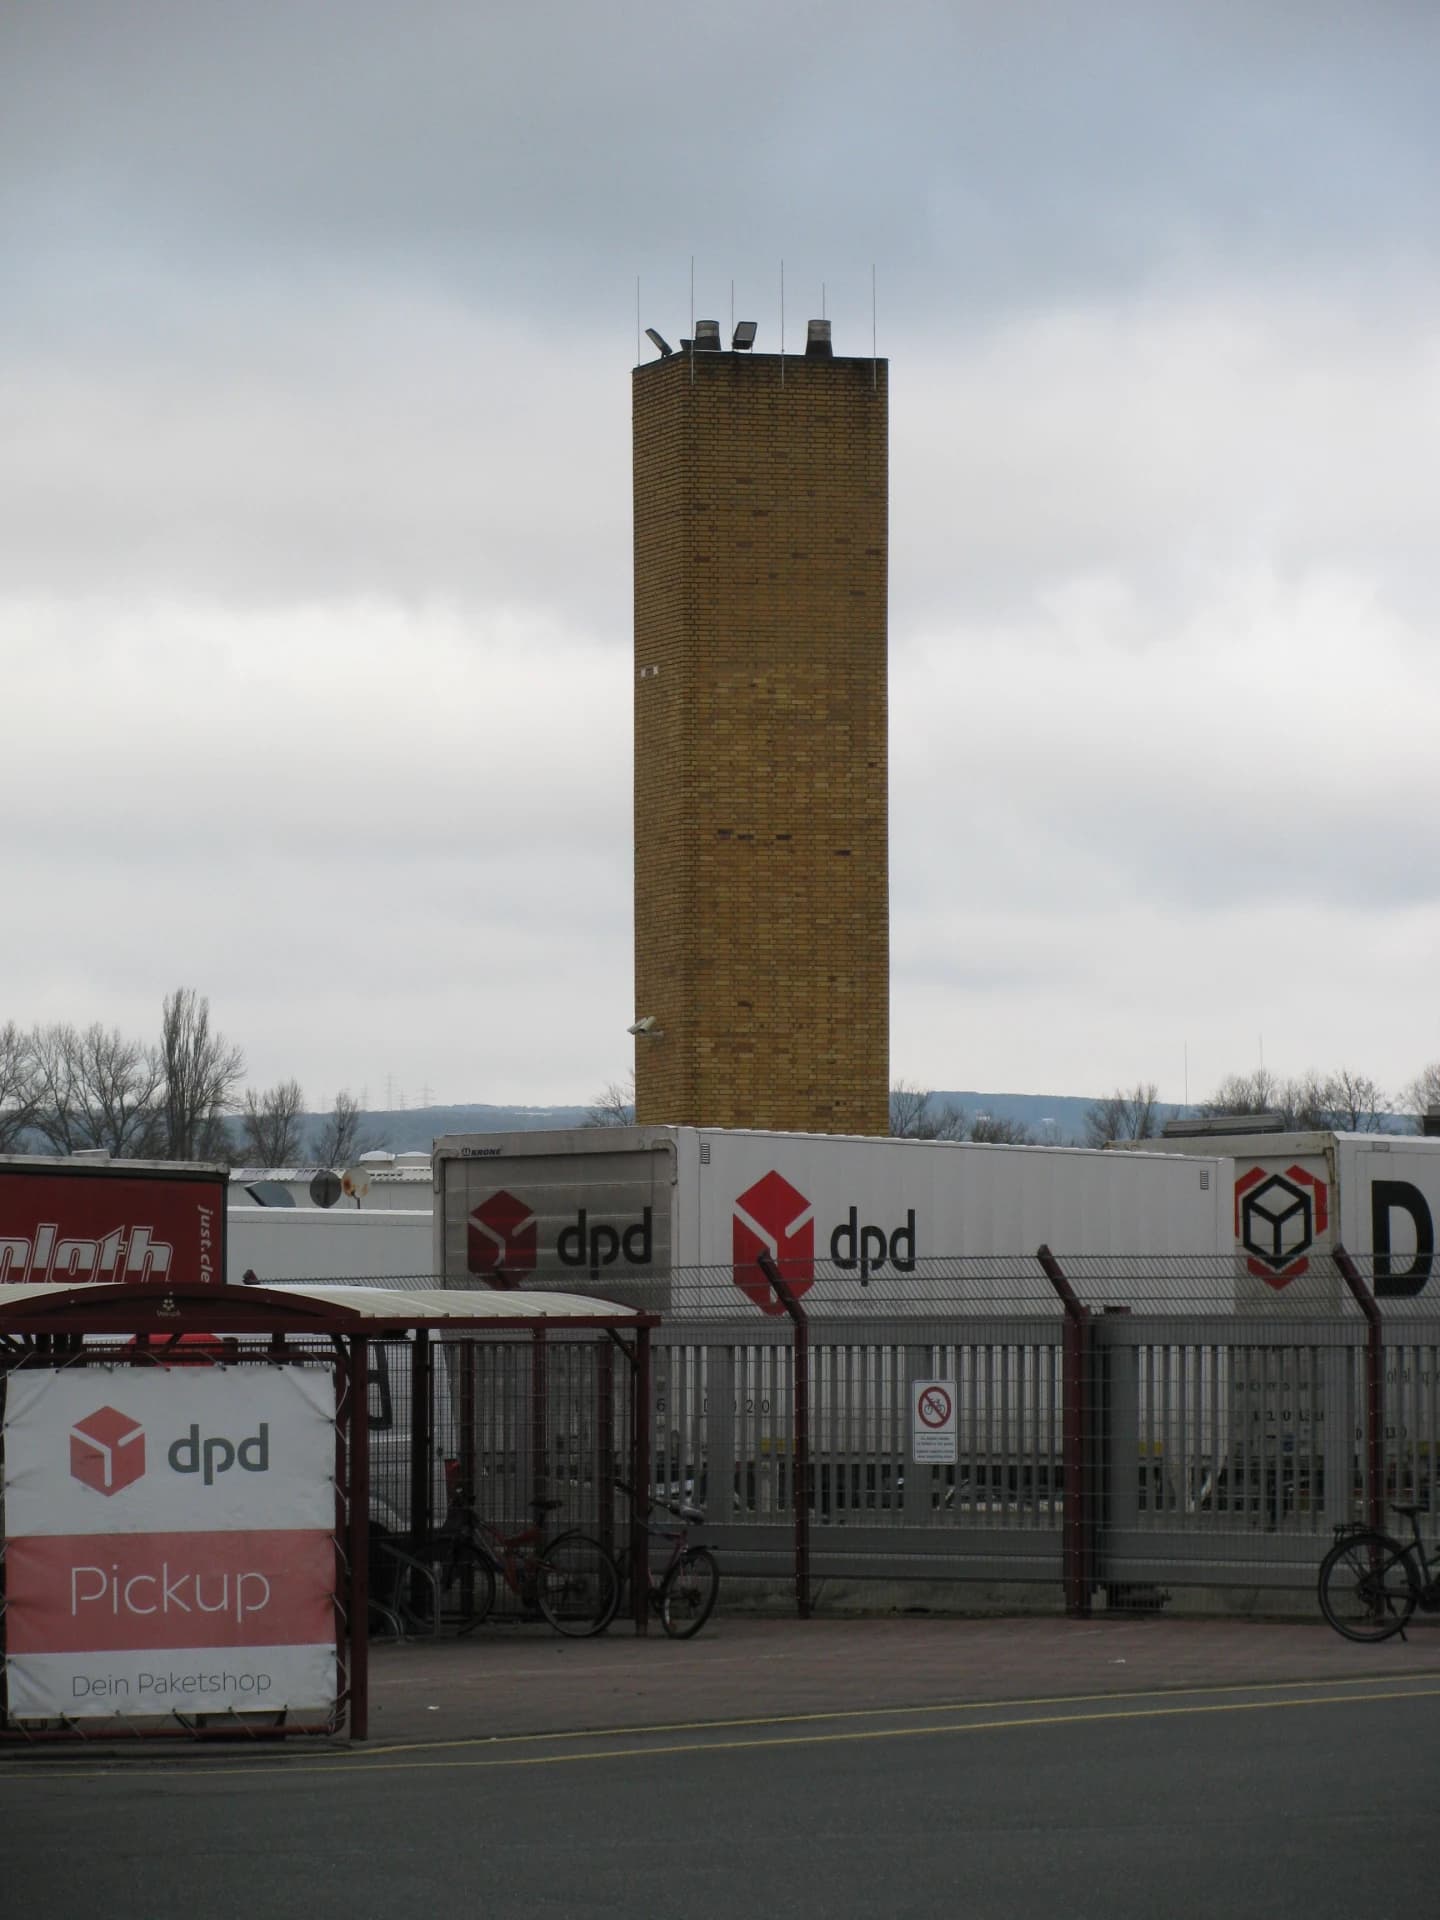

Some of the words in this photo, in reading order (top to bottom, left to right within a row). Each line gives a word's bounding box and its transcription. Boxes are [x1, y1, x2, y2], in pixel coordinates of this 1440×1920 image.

[557, 1206, 653, 1280] dpd
[830, 1206, 916, 1287] dpd
[1371, 1179, 1434, 1297] D
[168, 1422, 269, 1486] dpd
[70, 1562, 271, 1623] Pickup
[72, 1674, 129, 1697] Dein
[138, 1672, 271, 1696] Paketshop
